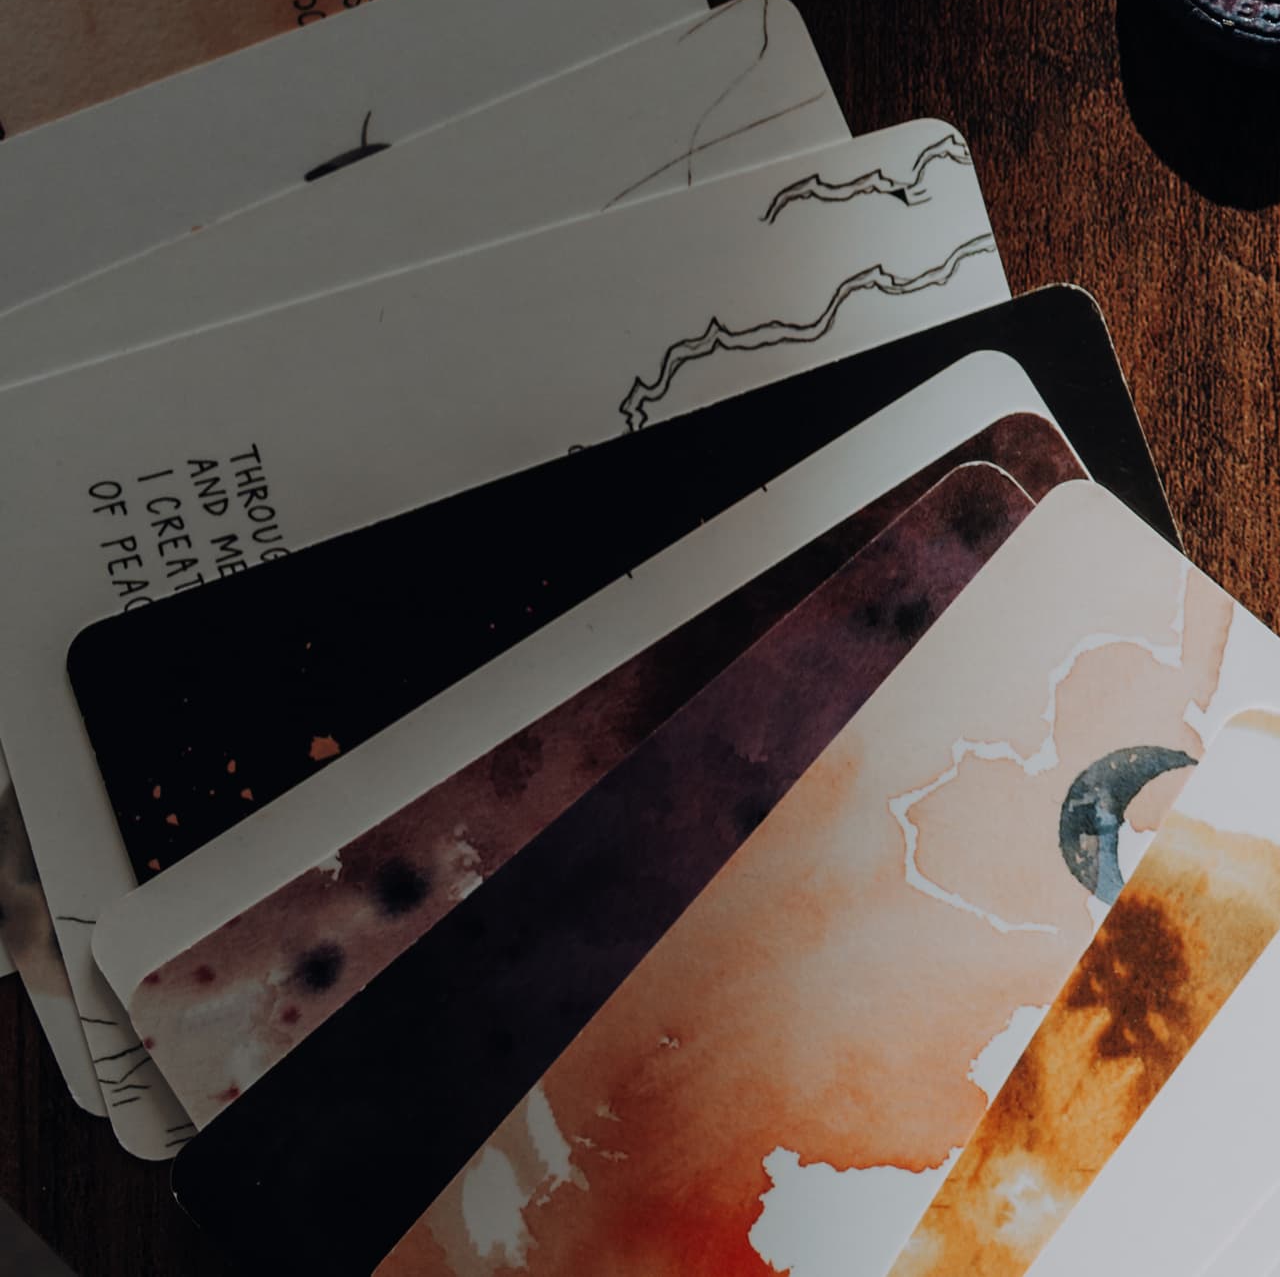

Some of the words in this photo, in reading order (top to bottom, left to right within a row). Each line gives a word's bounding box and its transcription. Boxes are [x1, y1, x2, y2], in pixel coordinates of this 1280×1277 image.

[136, 469, 174, 482] I
[186, 458, 229, 517] AND
[88, 480, 128, 516] OF
